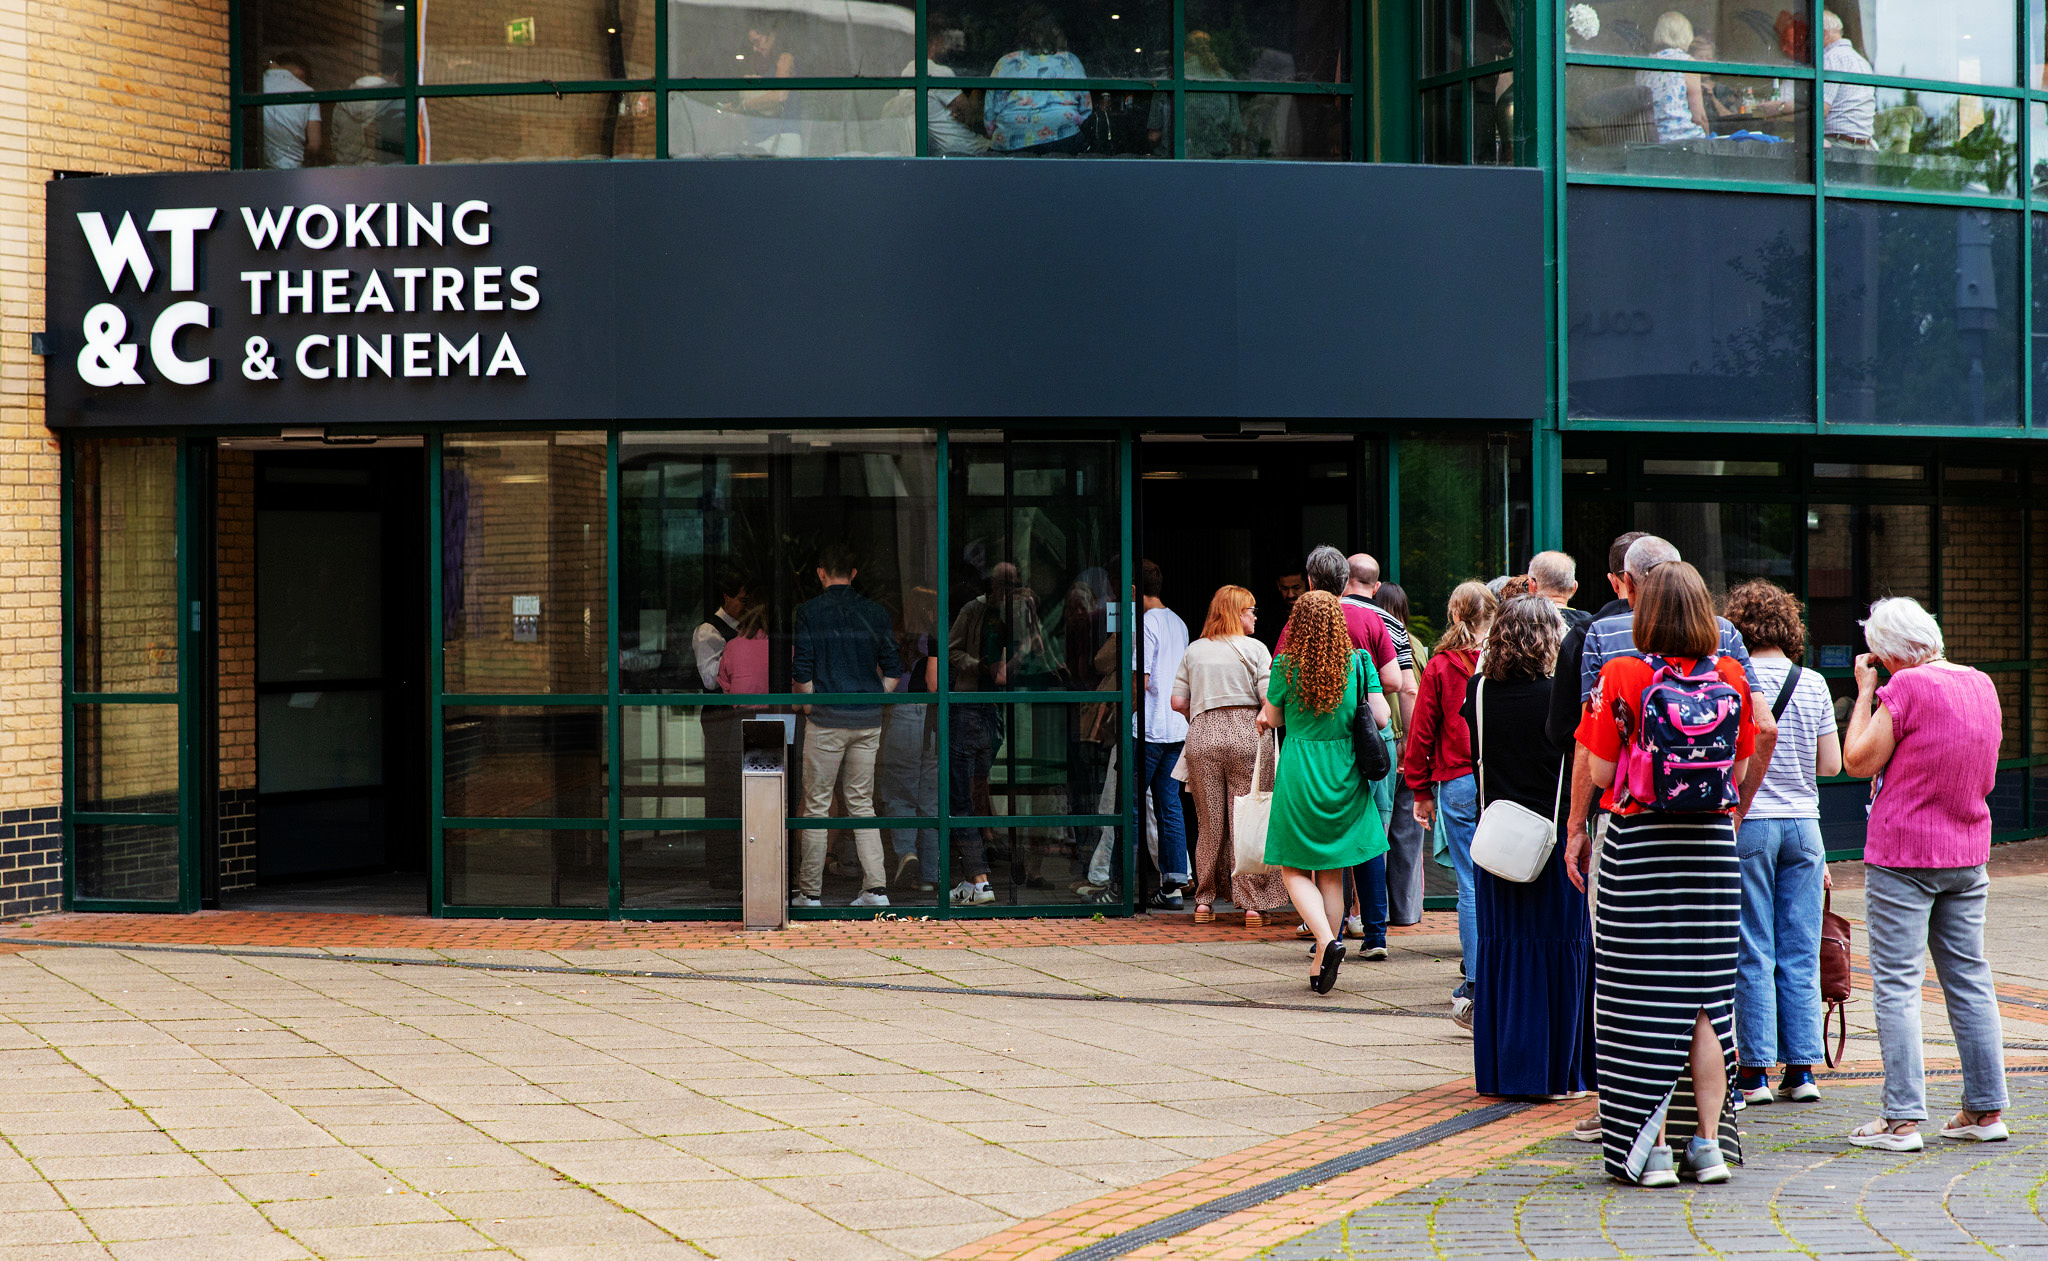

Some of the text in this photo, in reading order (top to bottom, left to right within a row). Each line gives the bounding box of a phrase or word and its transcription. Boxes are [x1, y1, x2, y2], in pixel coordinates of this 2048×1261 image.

[77, 207, 217, 293] WT
[240, 200, 489, 250] WOKING
[241, 266, 539, 314] THEATRES
[78, 301, 209, 386] &C
[242, 332, 526, 380] & CINEMA
